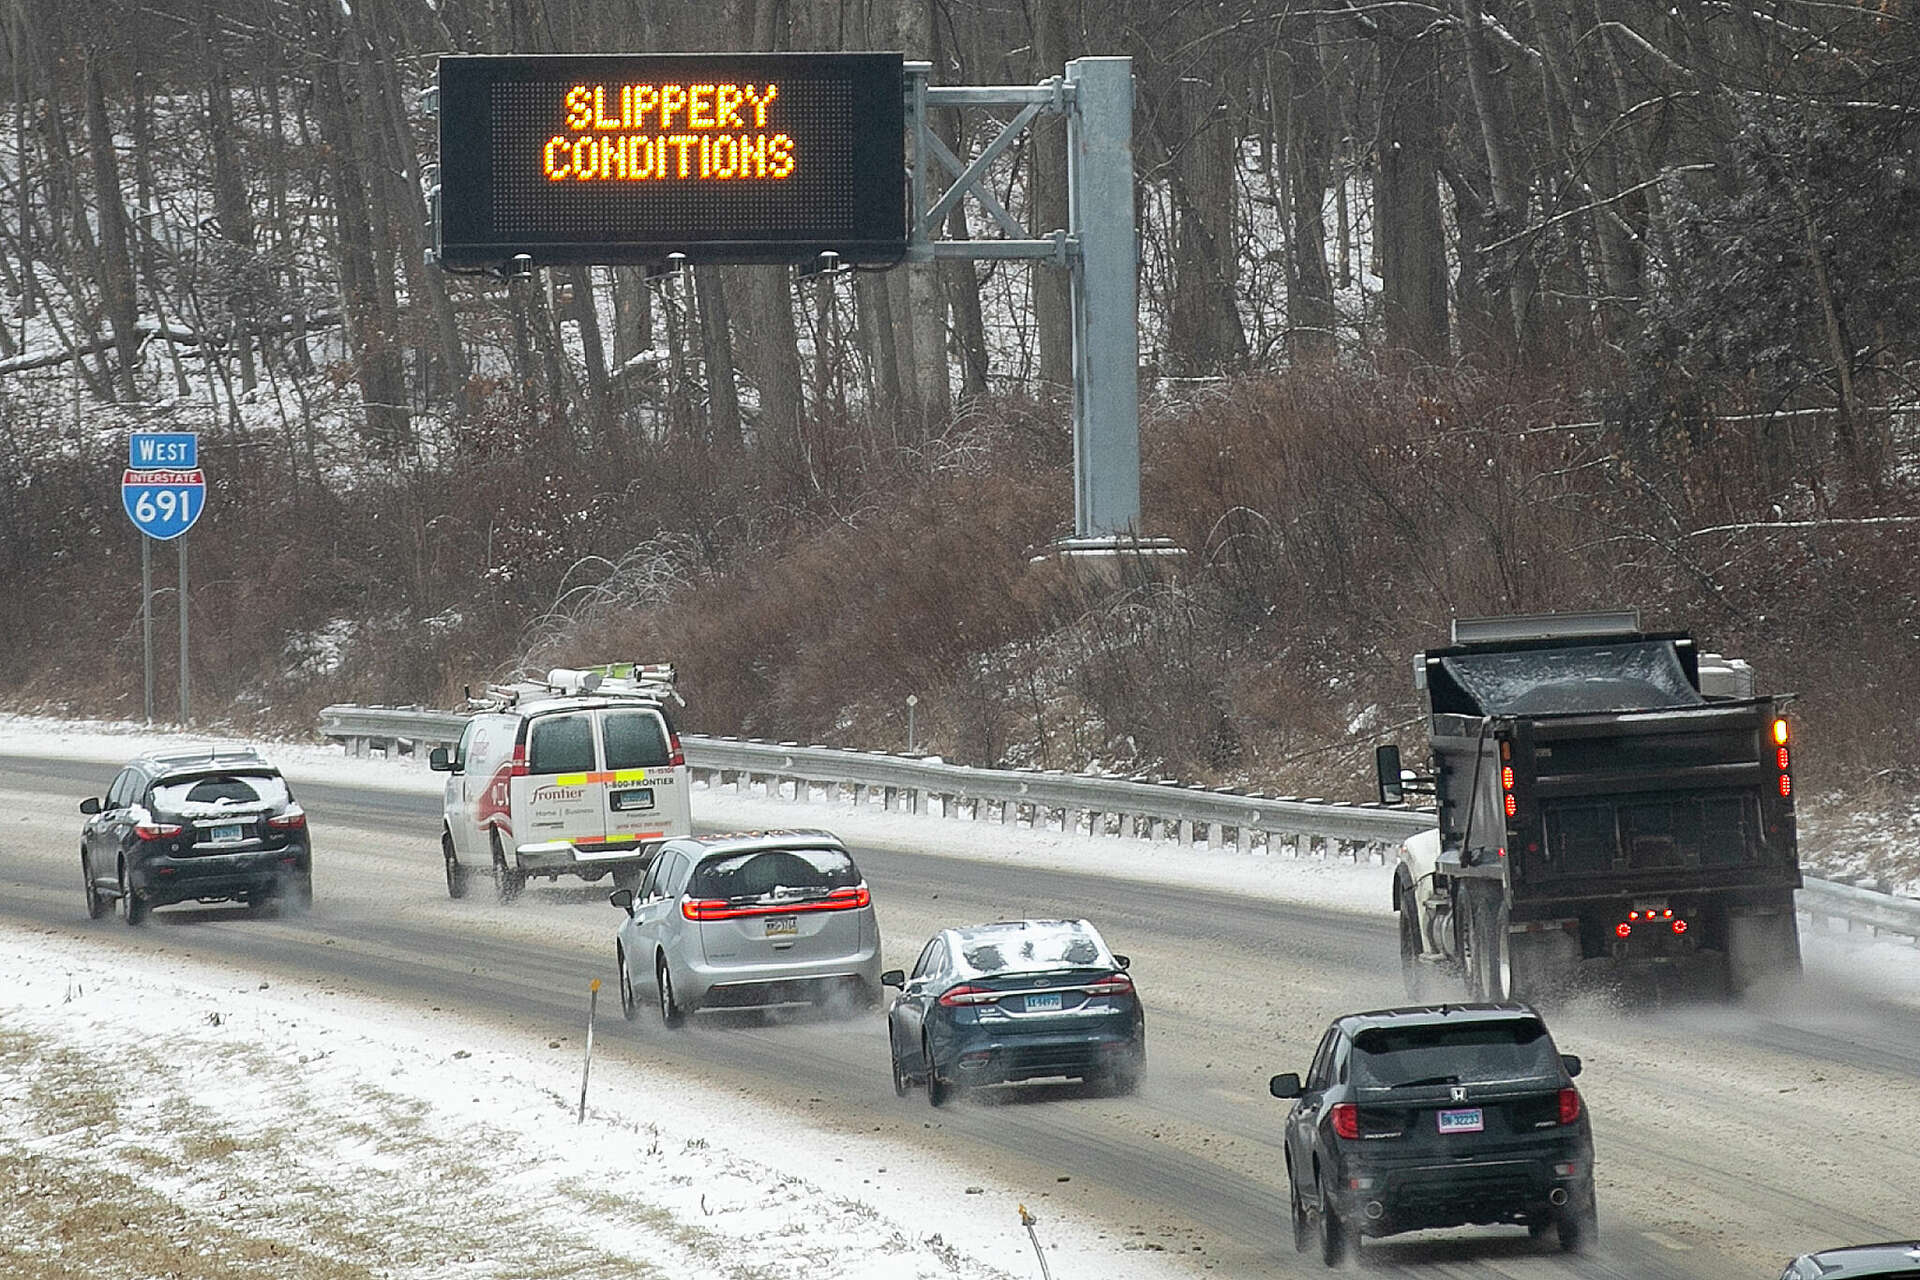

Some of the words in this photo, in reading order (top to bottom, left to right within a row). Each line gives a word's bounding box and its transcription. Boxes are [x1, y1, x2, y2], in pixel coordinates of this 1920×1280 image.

[565, 83, 778, 130] SLIPPERY
[543, 133, 796, 181] CONDITIONS
[129, 473, 198, 483] INTERSTATE
[135, 490, 190, 523] 691
[604, 777, 674, 789] 1-800-FRONTIER
